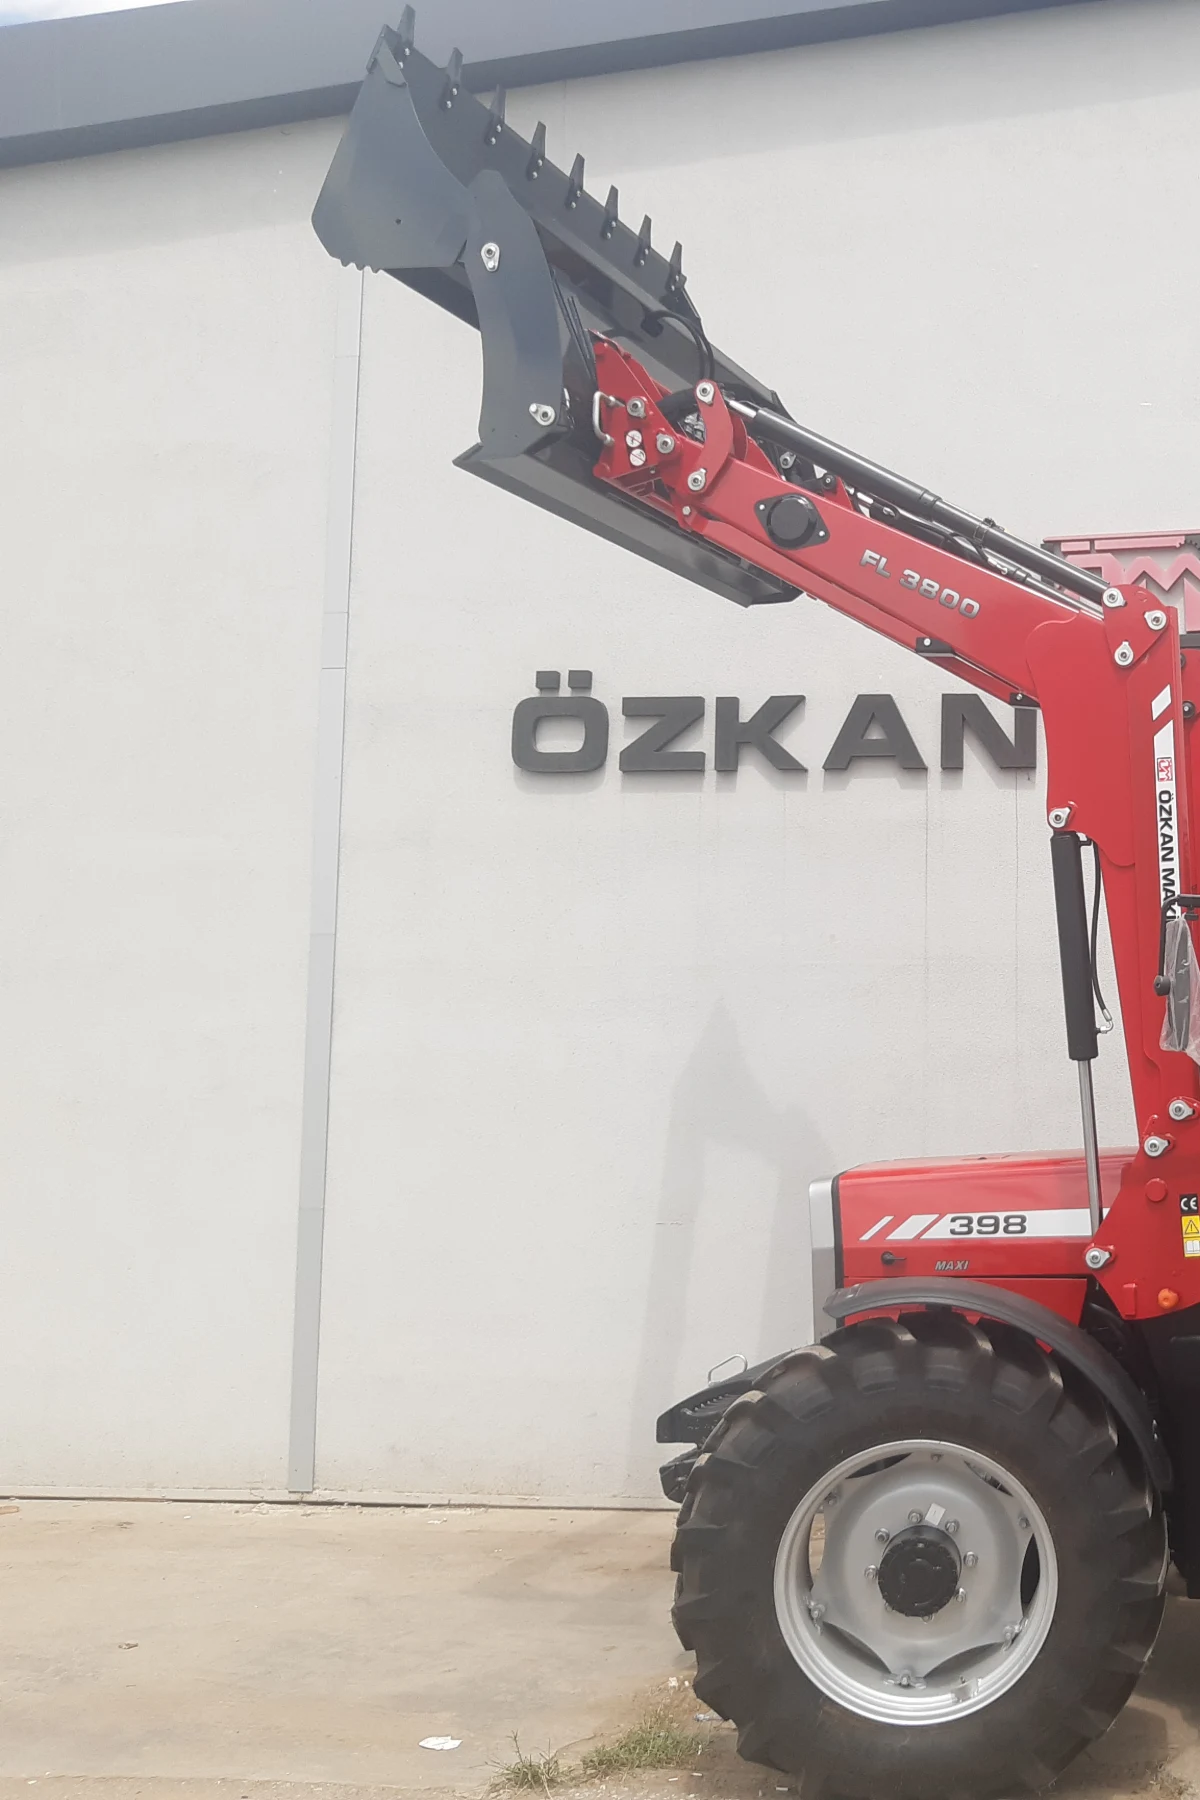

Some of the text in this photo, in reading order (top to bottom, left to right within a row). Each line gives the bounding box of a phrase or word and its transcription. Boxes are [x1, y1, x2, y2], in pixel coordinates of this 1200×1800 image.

[859, 549, 980, 619] FL 3800
[511, 669, 1038, 773] ÖZKAN
[1158, 789, 1180, 922] ÖZKAN MAKİ
[949, 1215, 1027, 1235] 398
[1180, 1197, 1198, 1210] CE
[934, 1260, 969, 1271] MAXI
